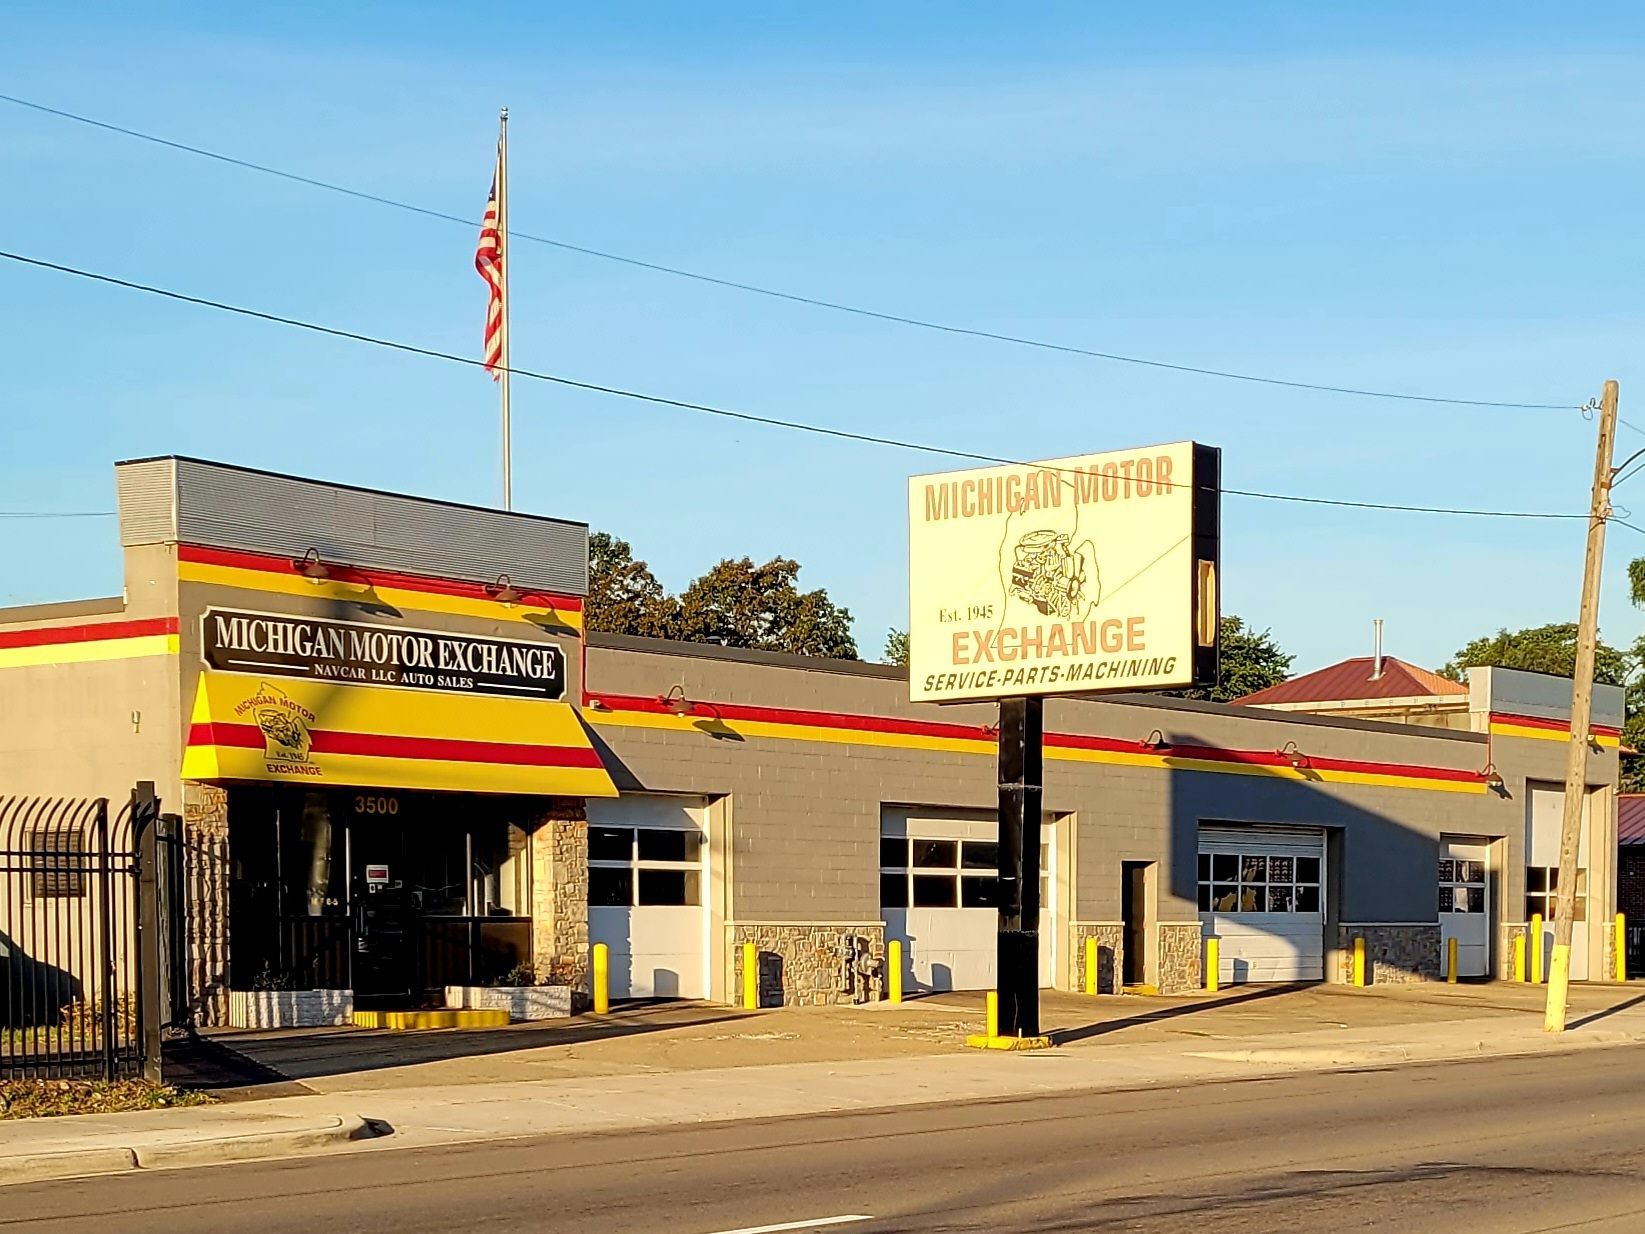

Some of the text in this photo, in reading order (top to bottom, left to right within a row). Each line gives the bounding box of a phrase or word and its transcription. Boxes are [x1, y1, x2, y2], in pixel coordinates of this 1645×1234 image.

[925, 455, 1173, 522] MICHIGAN MOTOR
[939, 605, 993, 622] Est. 1945
[215, 615, 556, 680] MICHIGAN MOTOR EXCHANGE
[952, 616, 1146, 665] EXCHANGE
[314, 663, 474, 689] NAVCAR LLC AUTO SALES
[234, 695, 316, 722] MICHIGAN MOTOR
[266, 763, 323, 776] EXCHANGE
[355, 796, 399, 815] 3500
